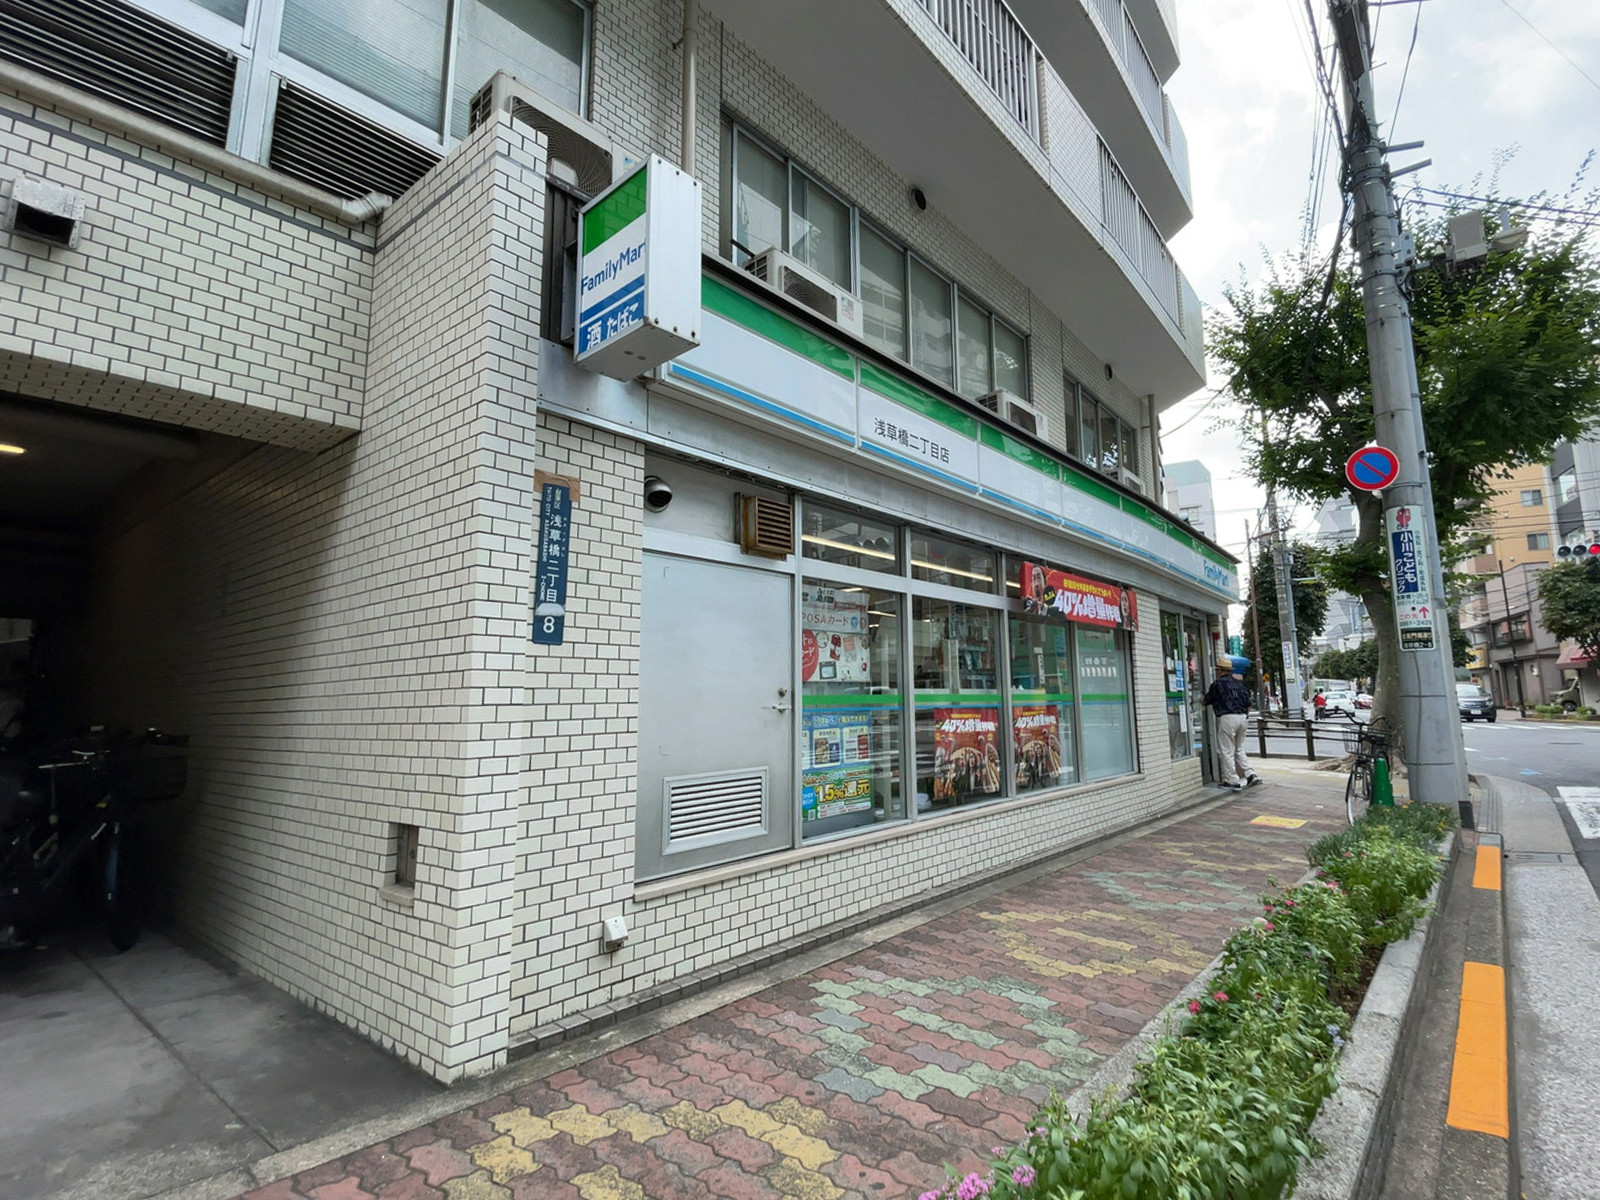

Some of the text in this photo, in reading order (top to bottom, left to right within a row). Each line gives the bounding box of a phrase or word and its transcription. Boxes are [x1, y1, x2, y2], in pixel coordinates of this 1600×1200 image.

[581, 242, 646, 297] FamilyMar
[586, 301, 640, 351] 酒 たばこ
[873, 416, 950, 464] 浅草橋二丁目店
[546, 513, 563, 603] 浅草橋二丁目
[1399, 531, 1418, 584] 小川こども
[543, 616, 555, 634] 8
